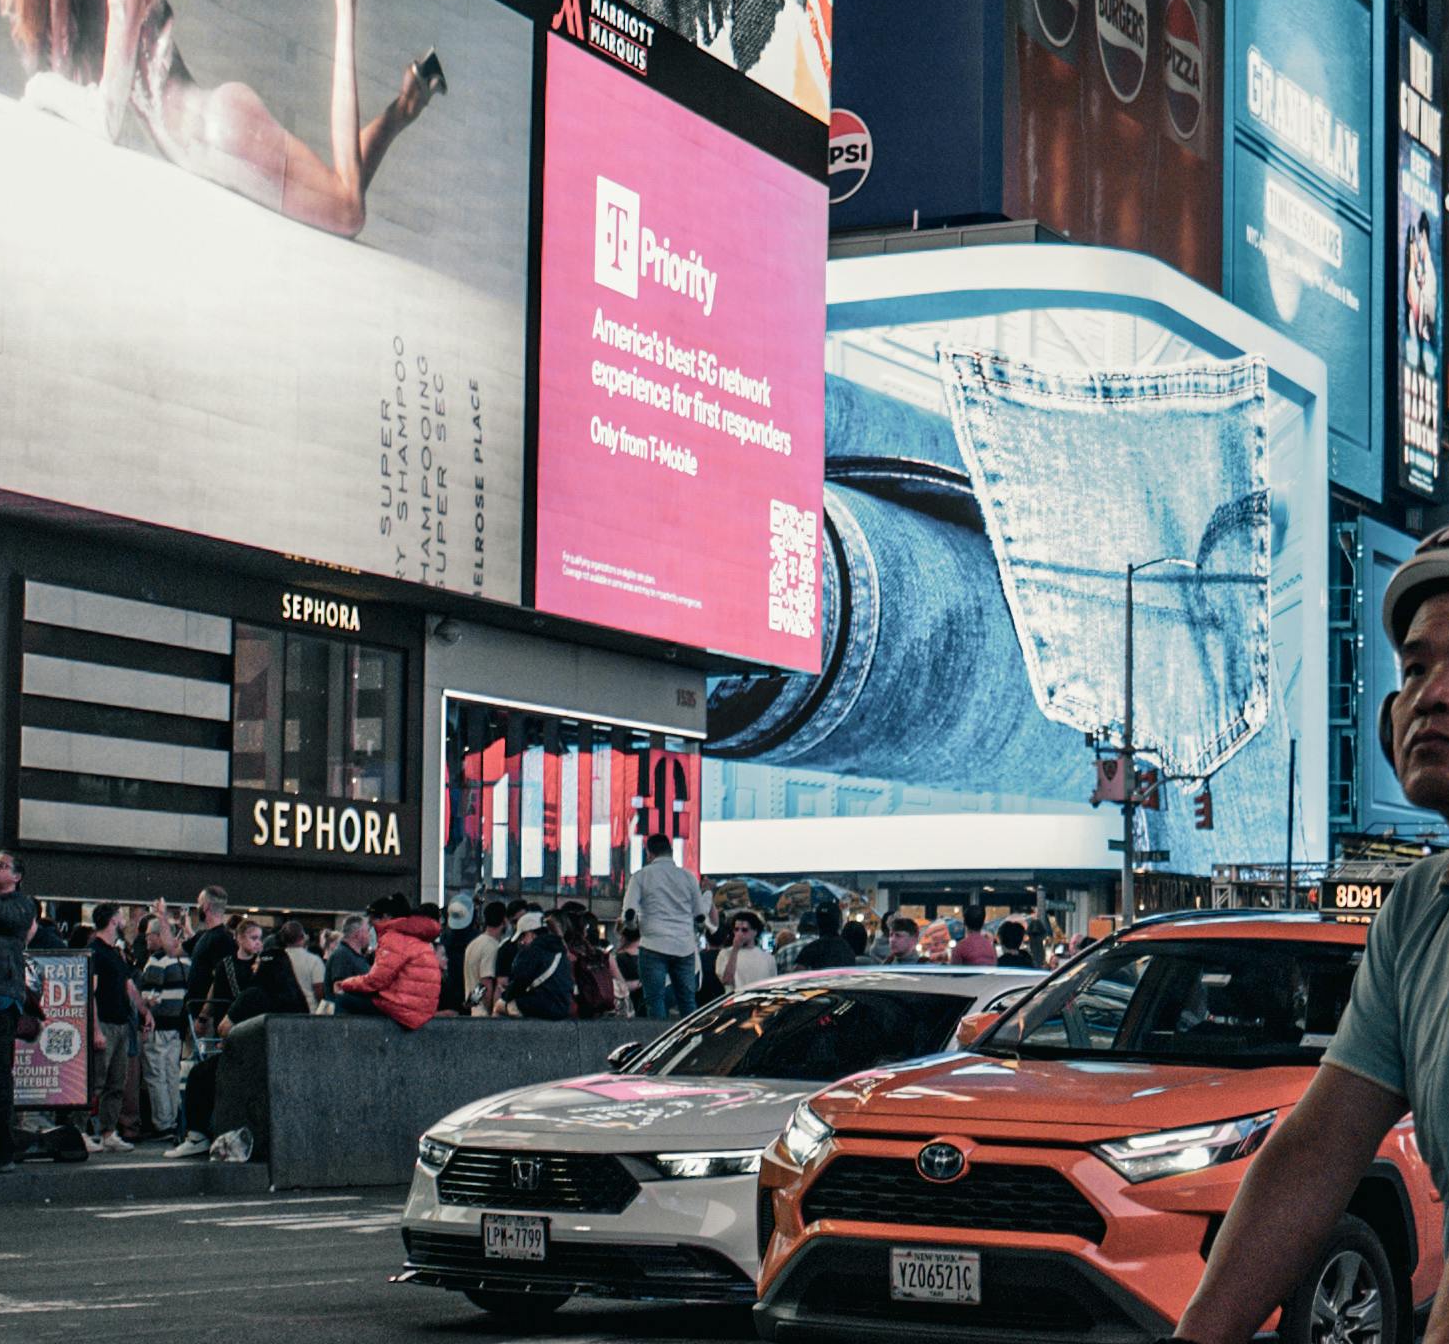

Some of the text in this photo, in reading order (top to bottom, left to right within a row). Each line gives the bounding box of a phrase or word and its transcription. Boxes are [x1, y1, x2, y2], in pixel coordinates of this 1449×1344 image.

[589, 22, 648, 70] MARQUIS
[1164, 41, 1201, 90] PIZZA
[640, 225, 718, 317] Priority
[592, 307, 772, 409] America's best 5G network
[393, 334, 408, 521] SHAMPOO
[433, 372, 447, 443] SEC
[469, 378, 484, 463] PLACE
[591, 359, 792, 457] experience for first responders
[379, 398, 393, 536] SUPER
[591, 415, 698, 477] Only from T-Mobile
[282, 592, 361, 633] SEPHORA
[253, 798, 402, 856] SEPHORA
[1335, 883, 1383, 909] 8D91
[899, 1261, 972, 1291] Y206521C
